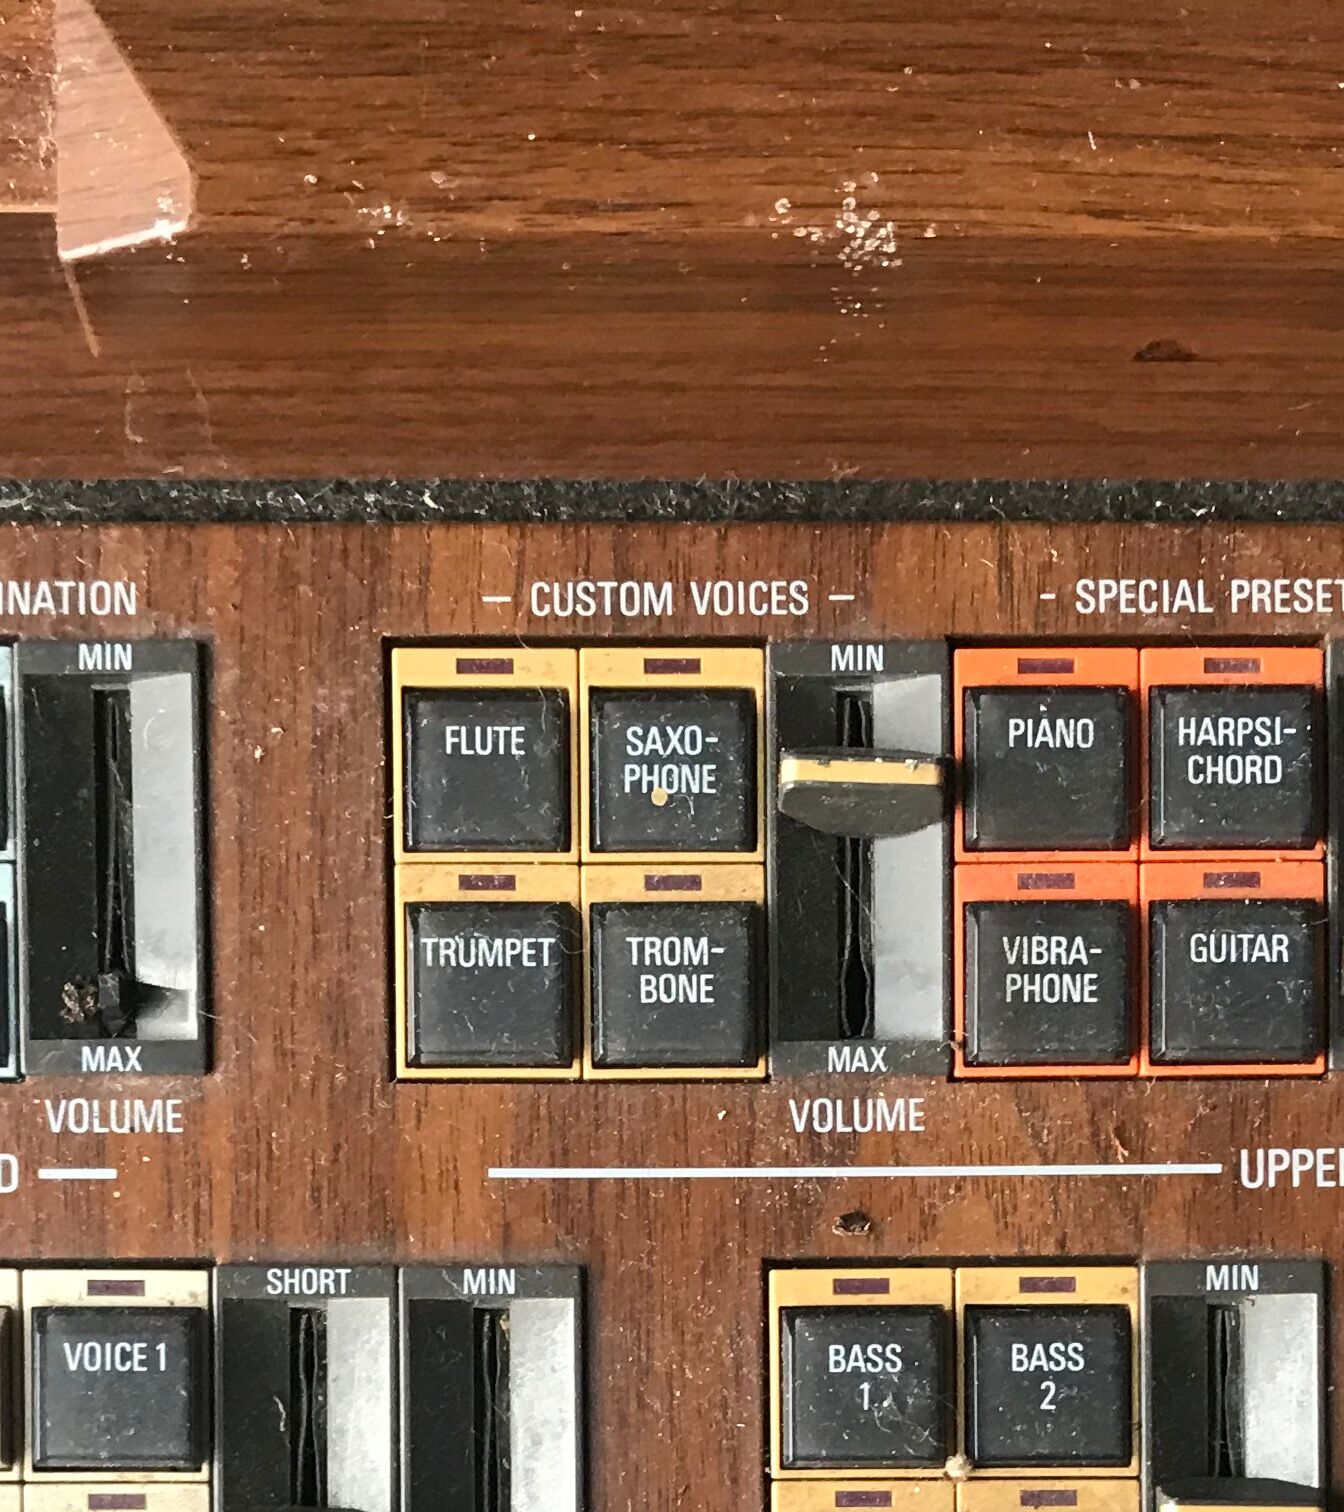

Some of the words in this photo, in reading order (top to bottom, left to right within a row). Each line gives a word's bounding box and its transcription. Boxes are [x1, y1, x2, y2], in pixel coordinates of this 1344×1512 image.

[530, 580, 673, 617] CUSTOM
[690, 580, 809, 616] VOICES
[1075, 578, 1214, 614] SPECIAL
[78, 643, 133, 671] MIN
[831, 644, 884, 672] MIN
[445, 725, 526, 757] FLUTE
[626, 724, 719, 758] SAXO-
[1008, 718, 1095, 749] PIANO
[1178, 716, 1297, 747] HARPSI-
[623, 763, 717, 795] PHONE
[1187, 754, 1283, 785] CHORD
[419, 935, 556, 968] TRUMPET
[625, 936, 725, 967] TROM-
[1002, 935, 1103, 966] VIBRA-
[1190, 933, 1289, 963] GUITAR
[639, 973, 715, 1004] BONE
[1005, 973, 1098, 1004] PHONE
[81, 1045, 143, 1072] MAX
[827, 1045, 888, 1073] MAX
[44, 1097, 184, 1134] VOLUME
[788, 1097, 925, 1133] VOLUME
[266, 1267, 352, 1295] SHORT
[462, 1268, 516, 1295] MIN
[1205, 1264, 1259, 1291] MIN
[62, 1341, 148, 1372] VOICE
[155, 1342, 166, 1372] 1
[828, 1343, 903, 1373] BASS
[1011, 1342, 1085, 1372] BASS
[859, 1381, 871, 1411] 1
[1040, 1380, 1057, 1411] 2
